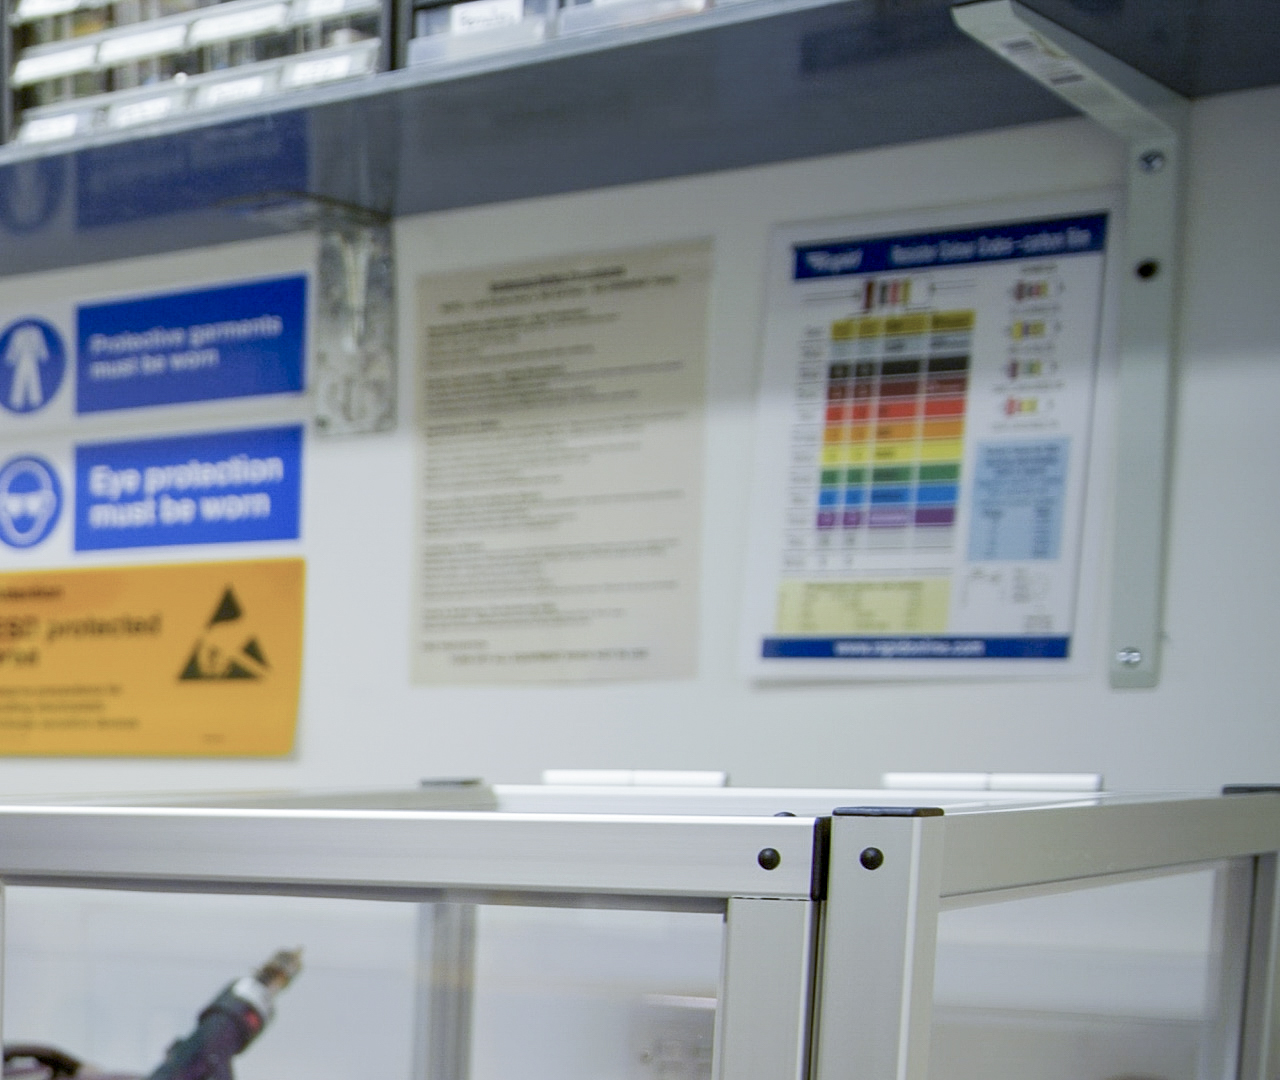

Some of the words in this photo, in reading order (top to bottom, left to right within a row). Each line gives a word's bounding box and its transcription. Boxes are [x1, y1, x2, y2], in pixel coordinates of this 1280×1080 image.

[91, 327, 184, 356] Protective
[190, 316, 282, 347] garments
[91, 358, 138, 379] must
[143, 353, 165, 373] be
[172, 349, 218, 370] worn
[90, 465, 140, 498] Eye
[145, 455, 283, 491] protection
[90, 502, 156, 528] must
[160, 494, 196, 523] be
[201, 492, 271, 520] worn
[47, 614, 162, 643] protected
